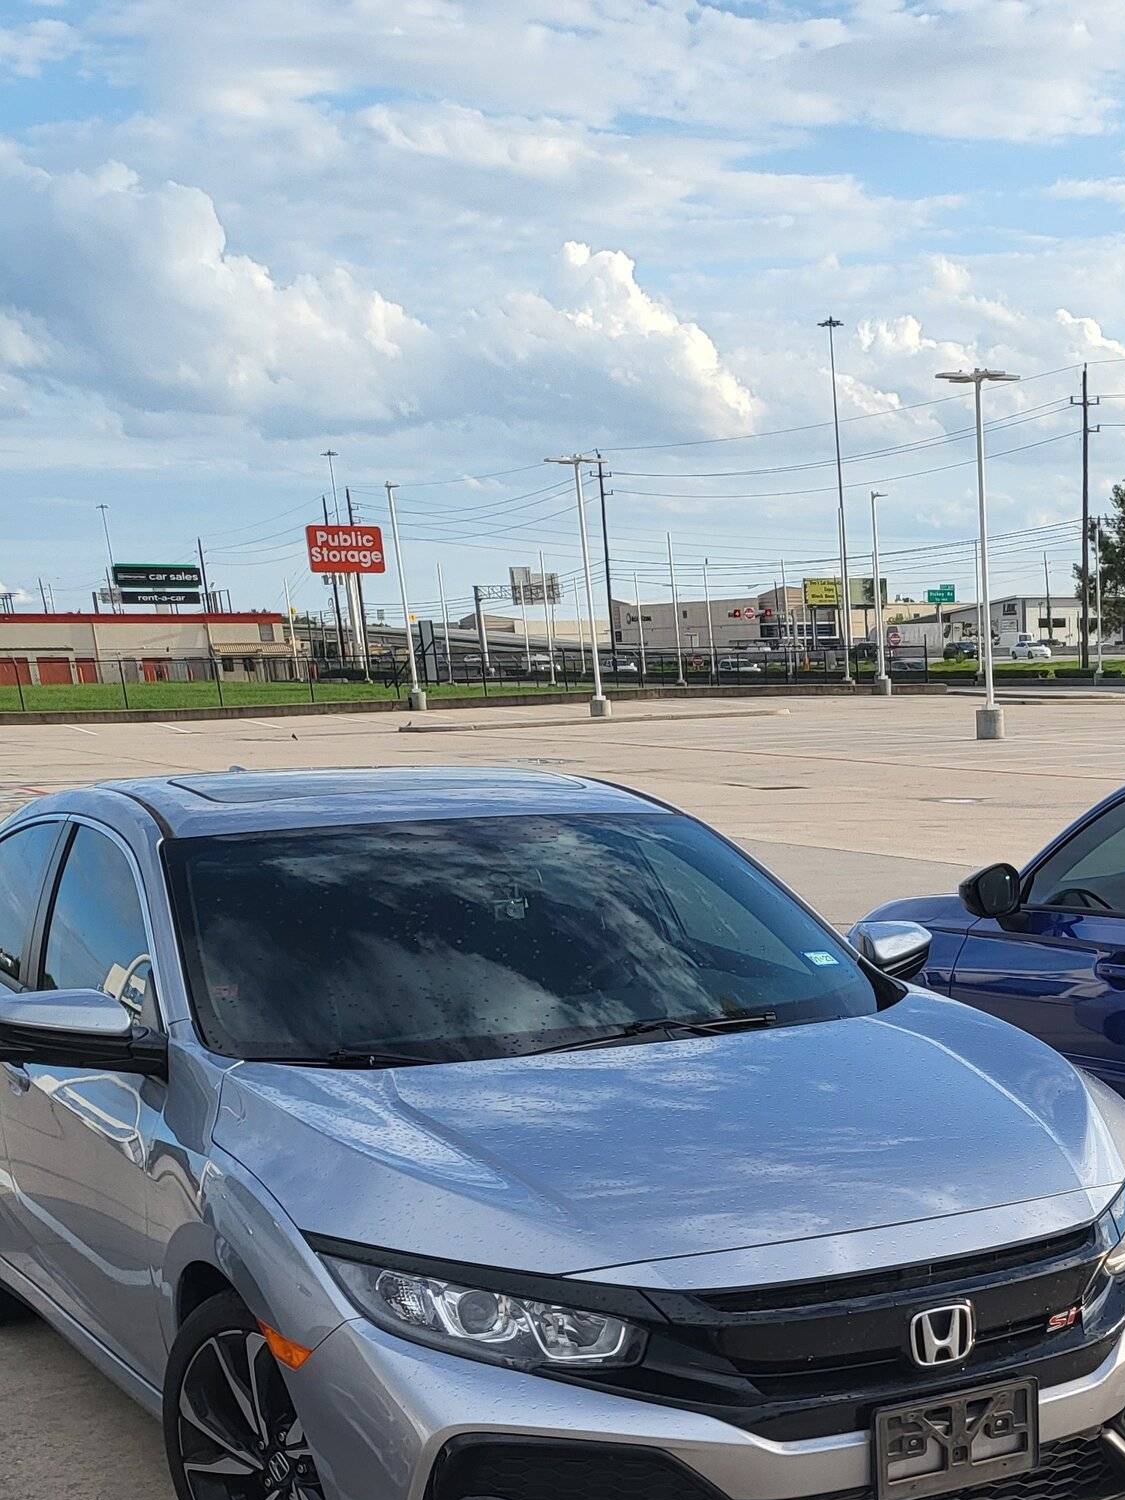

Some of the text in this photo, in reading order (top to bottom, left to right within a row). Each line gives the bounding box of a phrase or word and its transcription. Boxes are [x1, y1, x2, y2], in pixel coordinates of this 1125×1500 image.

[316, 531, 374, 546] Public
[311, 547, 382, 567] Storage
[148, 573, 168, 581] car
[169, 571, 199, 582] sales
